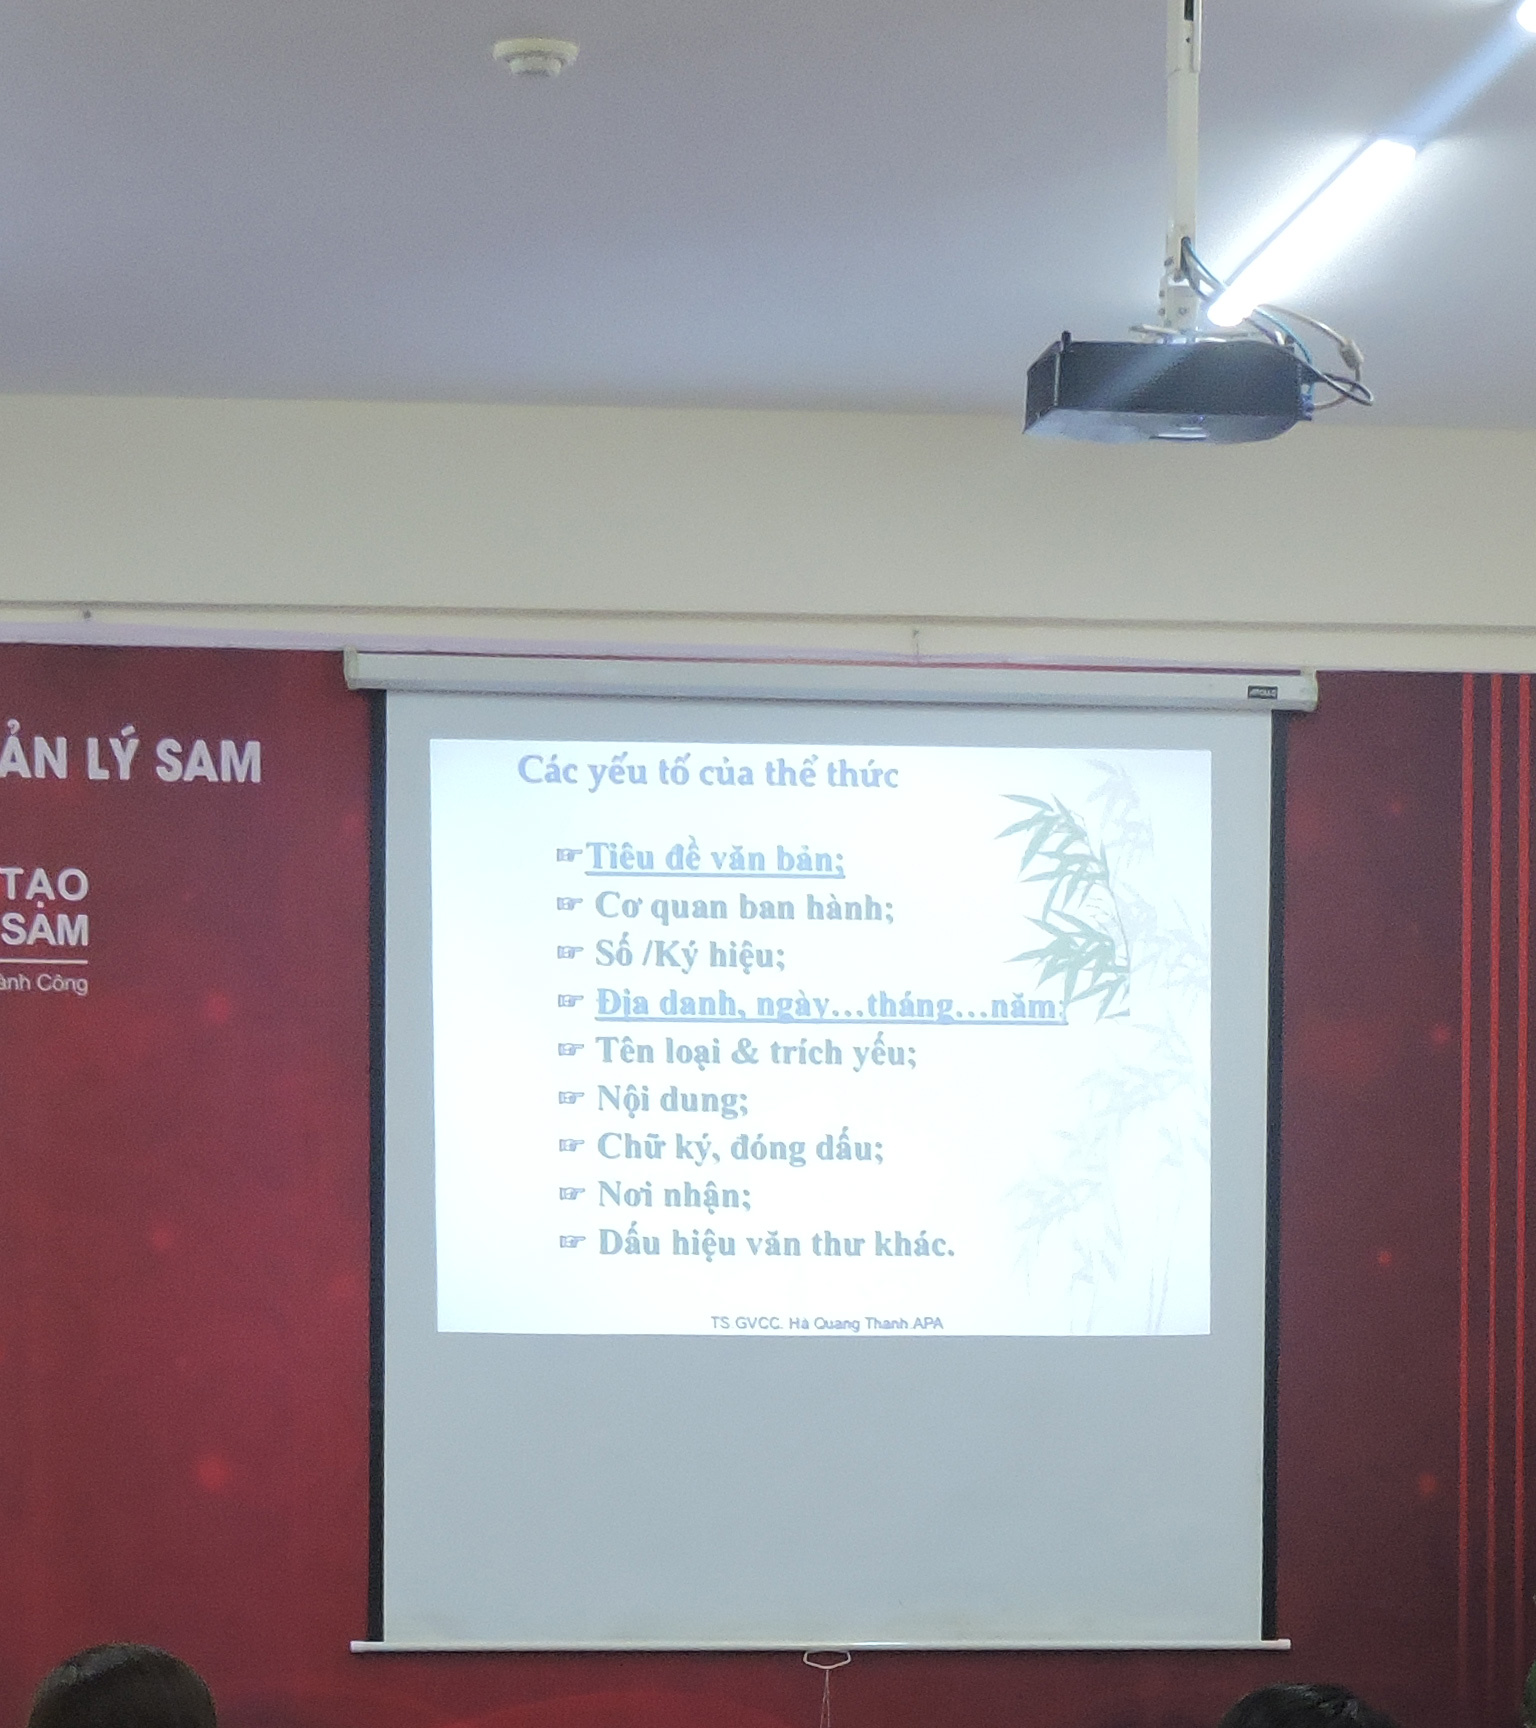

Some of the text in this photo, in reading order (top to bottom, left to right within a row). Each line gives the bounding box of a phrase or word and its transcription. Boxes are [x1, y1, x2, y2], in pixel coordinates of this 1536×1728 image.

[88, 726, 139, 780] LÝ
[156, 739, 260, 783] SAM
[518, 751, 898, 793] Các yếu tố của thể thức
[586, 835, 846, 879] Tiêu đề văn bản;
[0, 867, 88, 908] TẠO
[595, 891, 893, 926] Cơ quan ban hành;
[1, 913, 88, 946] SAM
[596, 932, 785, 975] Số /Ký hiệu;
[37, 973, 88, 996] Công
[596, 988, 649, 1019] Địa
[659, 989, 747, 1021] danh,
[596, 1031, 916, 1072] Tên loại & trích yếu;
[598, 1084, 748, 1120] Nội dung;
[598, 1126, 883, 1167] Chữ ký, đóng dấu;
[599, 1181, 751, 1215] Nơi nhận;
[600, 1221, 954, 1262] Dấu hiệu văn thư khác.
